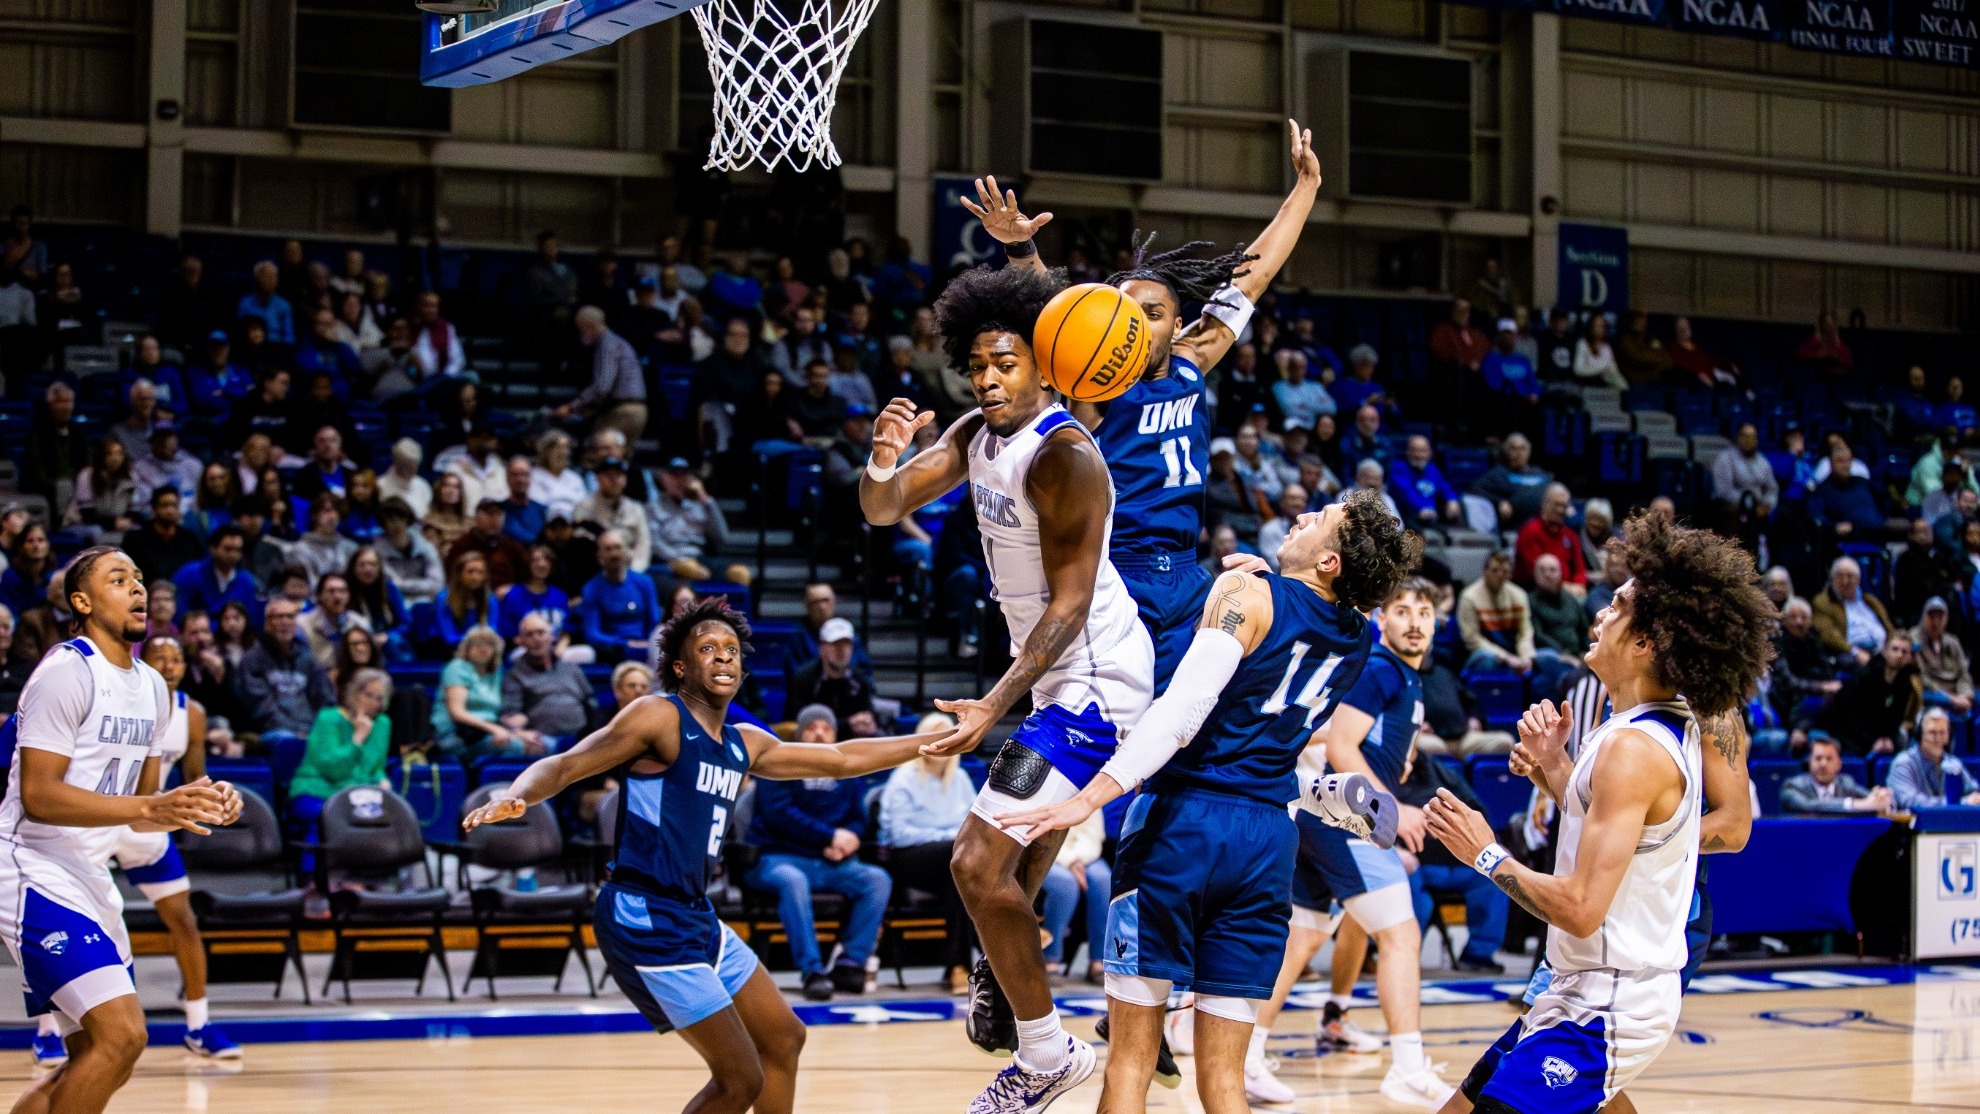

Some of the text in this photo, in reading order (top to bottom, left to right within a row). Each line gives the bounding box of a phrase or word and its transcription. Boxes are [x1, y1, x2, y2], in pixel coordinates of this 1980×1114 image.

[1683, 0, 1771, 31] NCAA
[1807, 0, 1875, 31] NCAA
[1919, 11, 1978, 40] NCAA
[1791, 28, 1893, 55] FINAL FOUR
[1902, 35, 1973, 64] SWEET
[1581, 269, 1608, 308] D
[1090, 317, 1139, 386] Wilson
[1138, 394, 1199, 434] UMW
[1160, 436, 1202, 488] 11
[972, 483, 1021, 528] PTAINS
[1260, 640, 1345, 729] 14
[98, 715, 155, 747] CAPTAIN
[696, 761, 743, 801] UMW
[707, 804, 727, 858] 2
[1542, 1055, 1578, 1084] CNU
